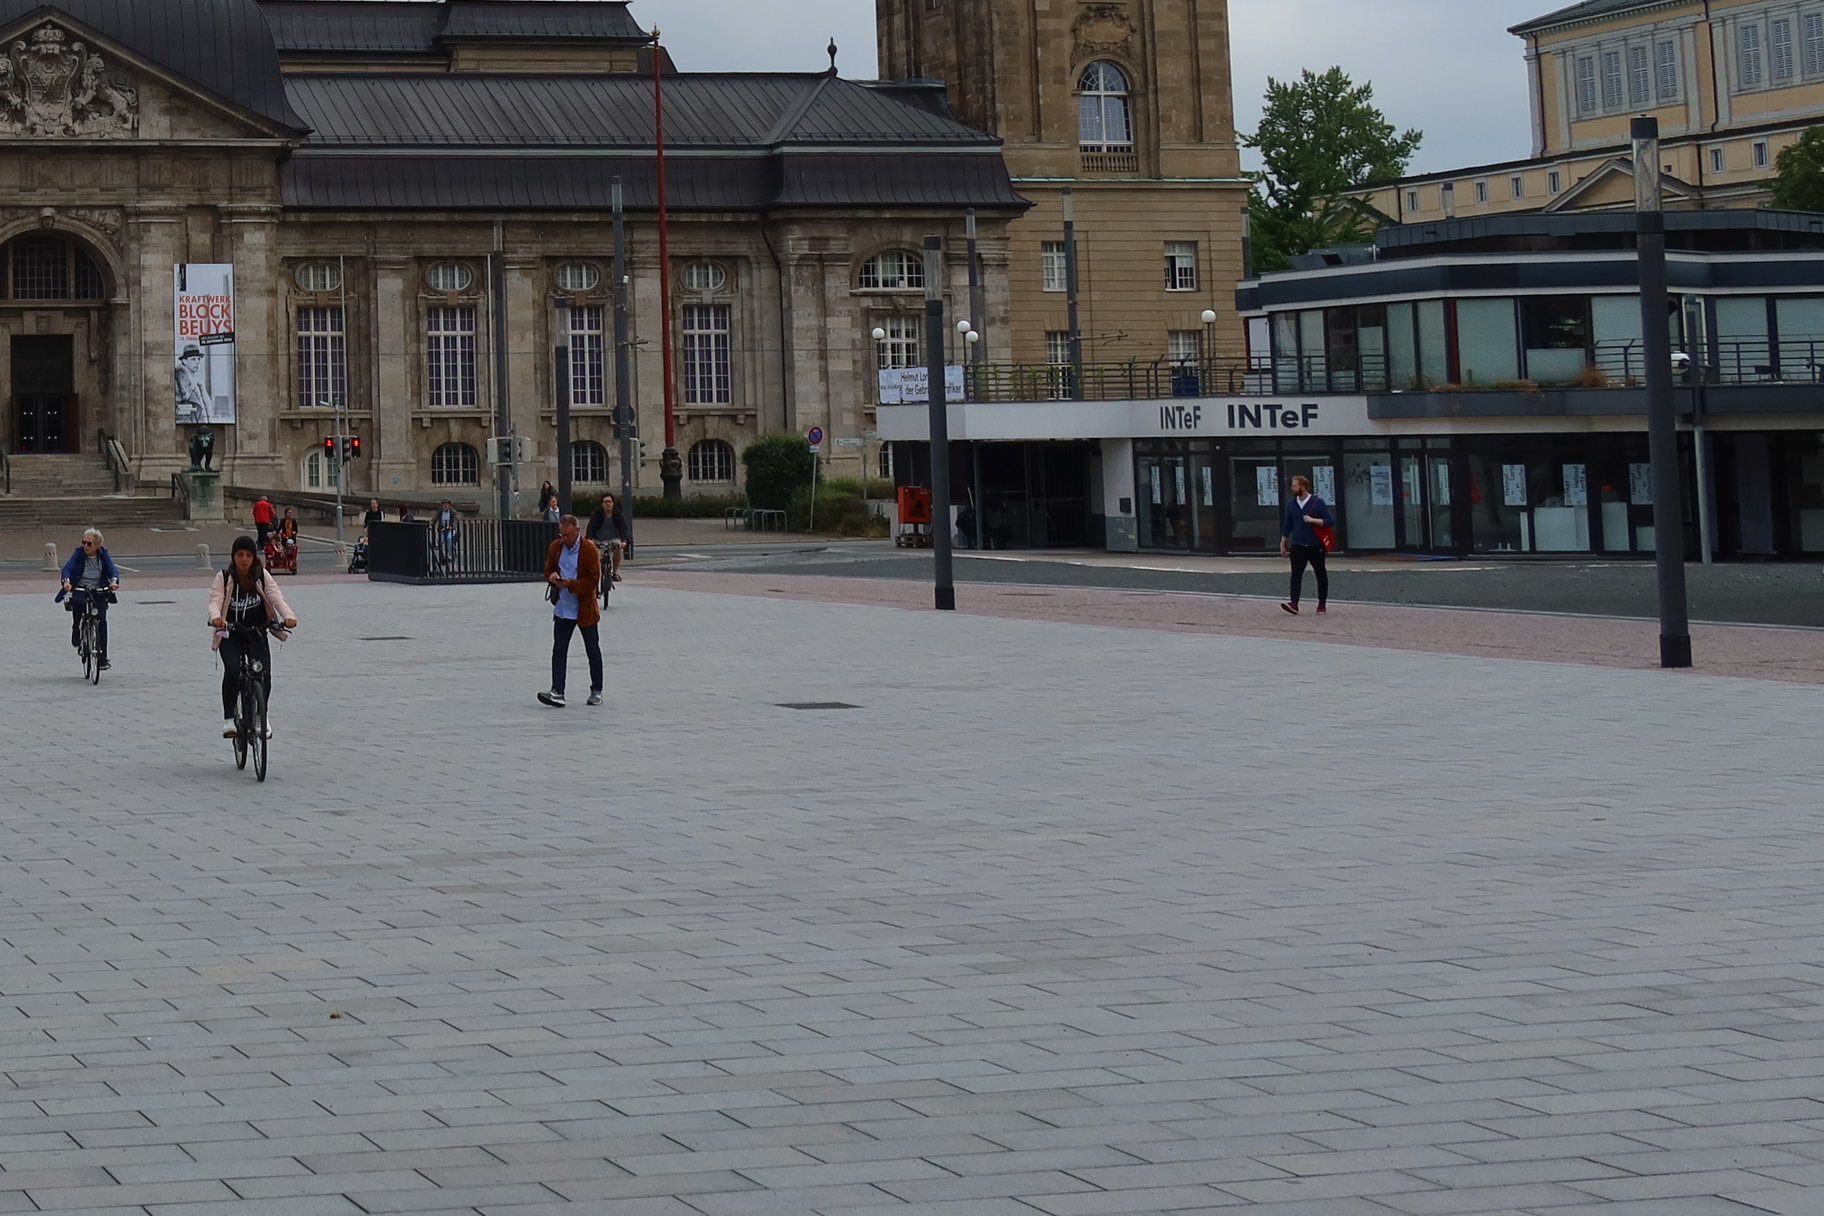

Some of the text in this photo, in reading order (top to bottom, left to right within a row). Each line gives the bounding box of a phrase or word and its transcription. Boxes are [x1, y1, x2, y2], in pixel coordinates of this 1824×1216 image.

[179, 295, 231, 303] KRAFTWERK
[179, 304, 232, 319] BLOCK
[179, 320, 232, 335] BEUYS
[900, 371, 919, 382] Helmut
[905, 384, 914, 395] der
[1160, 405, 1202, 430] INTeF
[1227, 404, 1319, 429] INTeF
